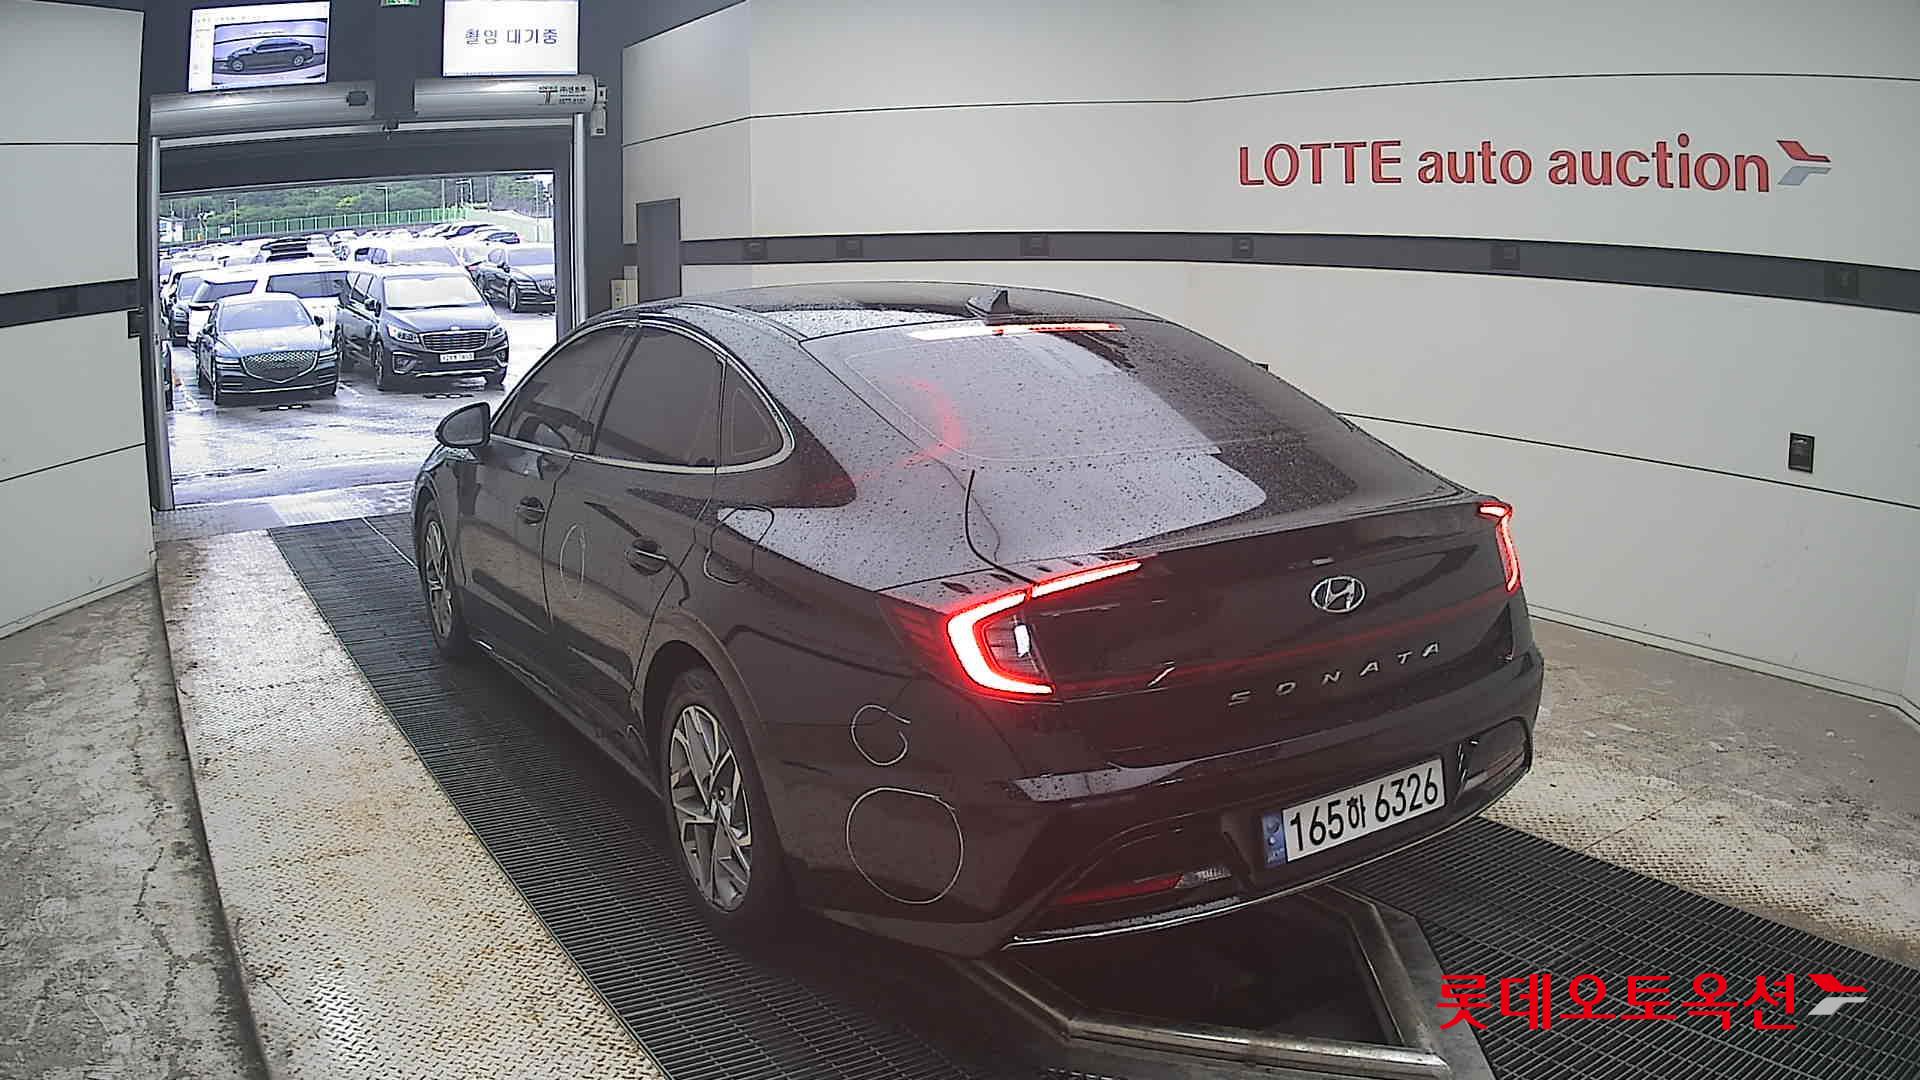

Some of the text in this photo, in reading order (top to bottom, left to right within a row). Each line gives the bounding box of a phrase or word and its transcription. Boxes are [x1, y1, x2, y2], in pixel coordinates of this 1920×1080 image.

[506, 28, 558, 45] 대기중
[1239, 133, 1769, 192] LOTTE auto auction
[1228, 642, 1440, 706] SONATA
[1290, 767, 1438, 851] 165하 6326
